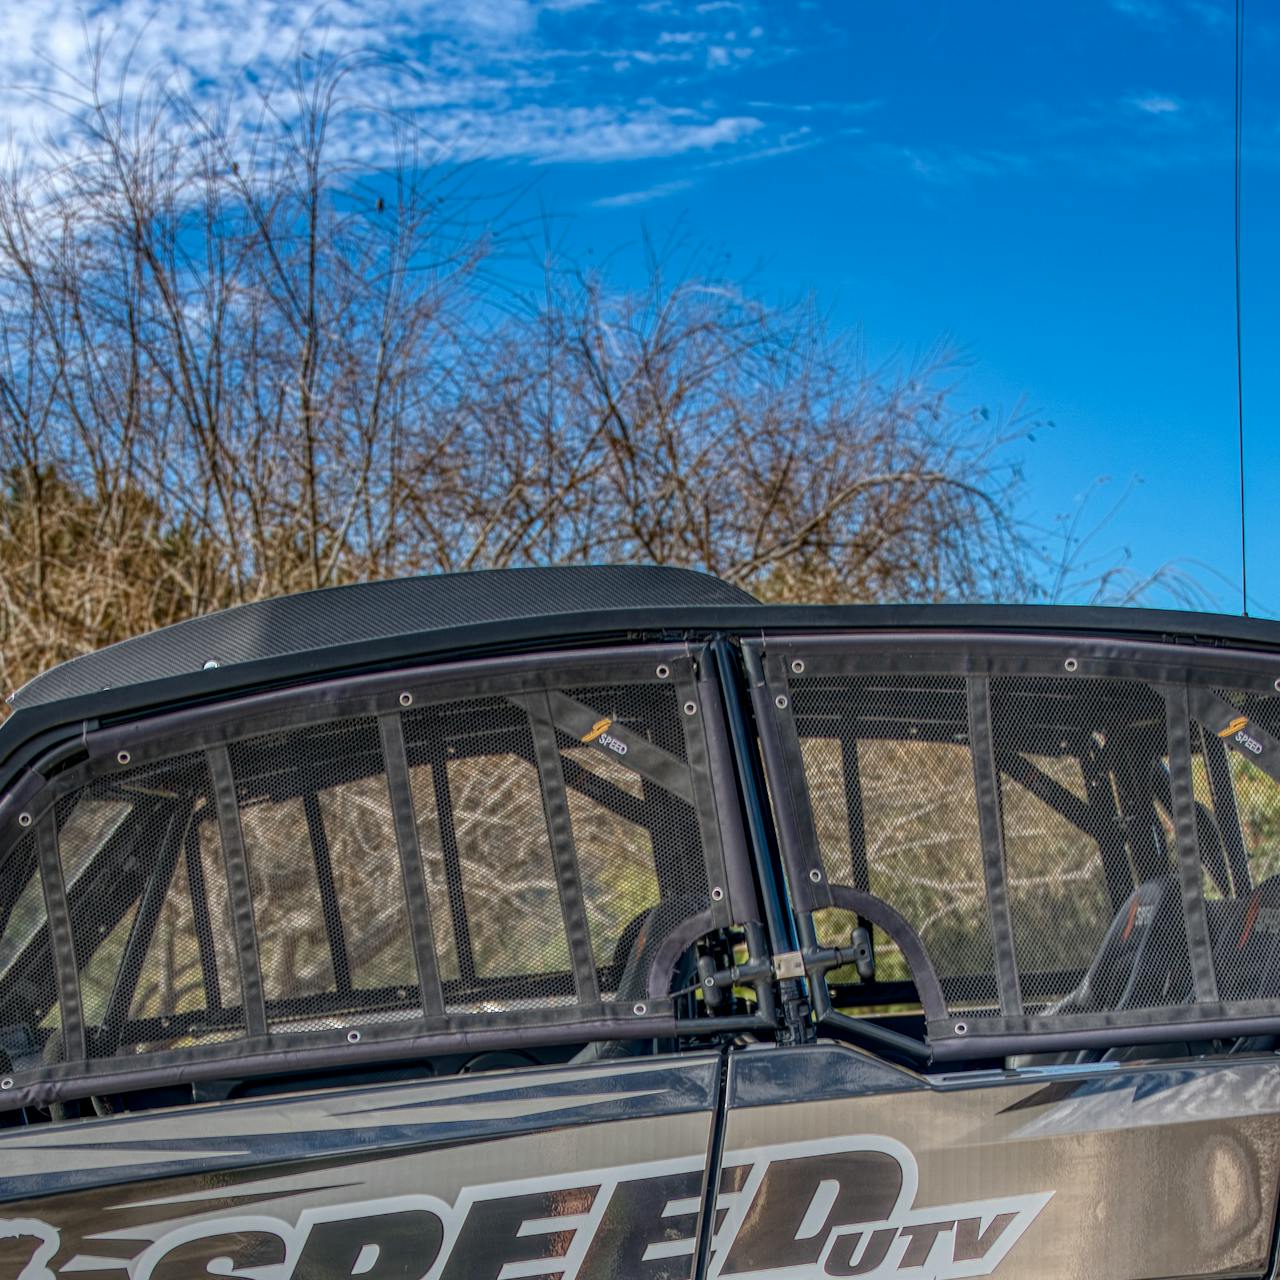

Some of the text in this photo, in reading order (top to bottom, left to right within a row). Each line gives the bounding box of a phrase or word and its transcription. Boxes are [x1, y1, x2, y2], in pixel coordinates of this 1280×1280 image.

[599, 733, 628, 755] SPEED
[1235, 731, 1263, 754] SPEED
[822, 1210, 1021, 1277] UTV
